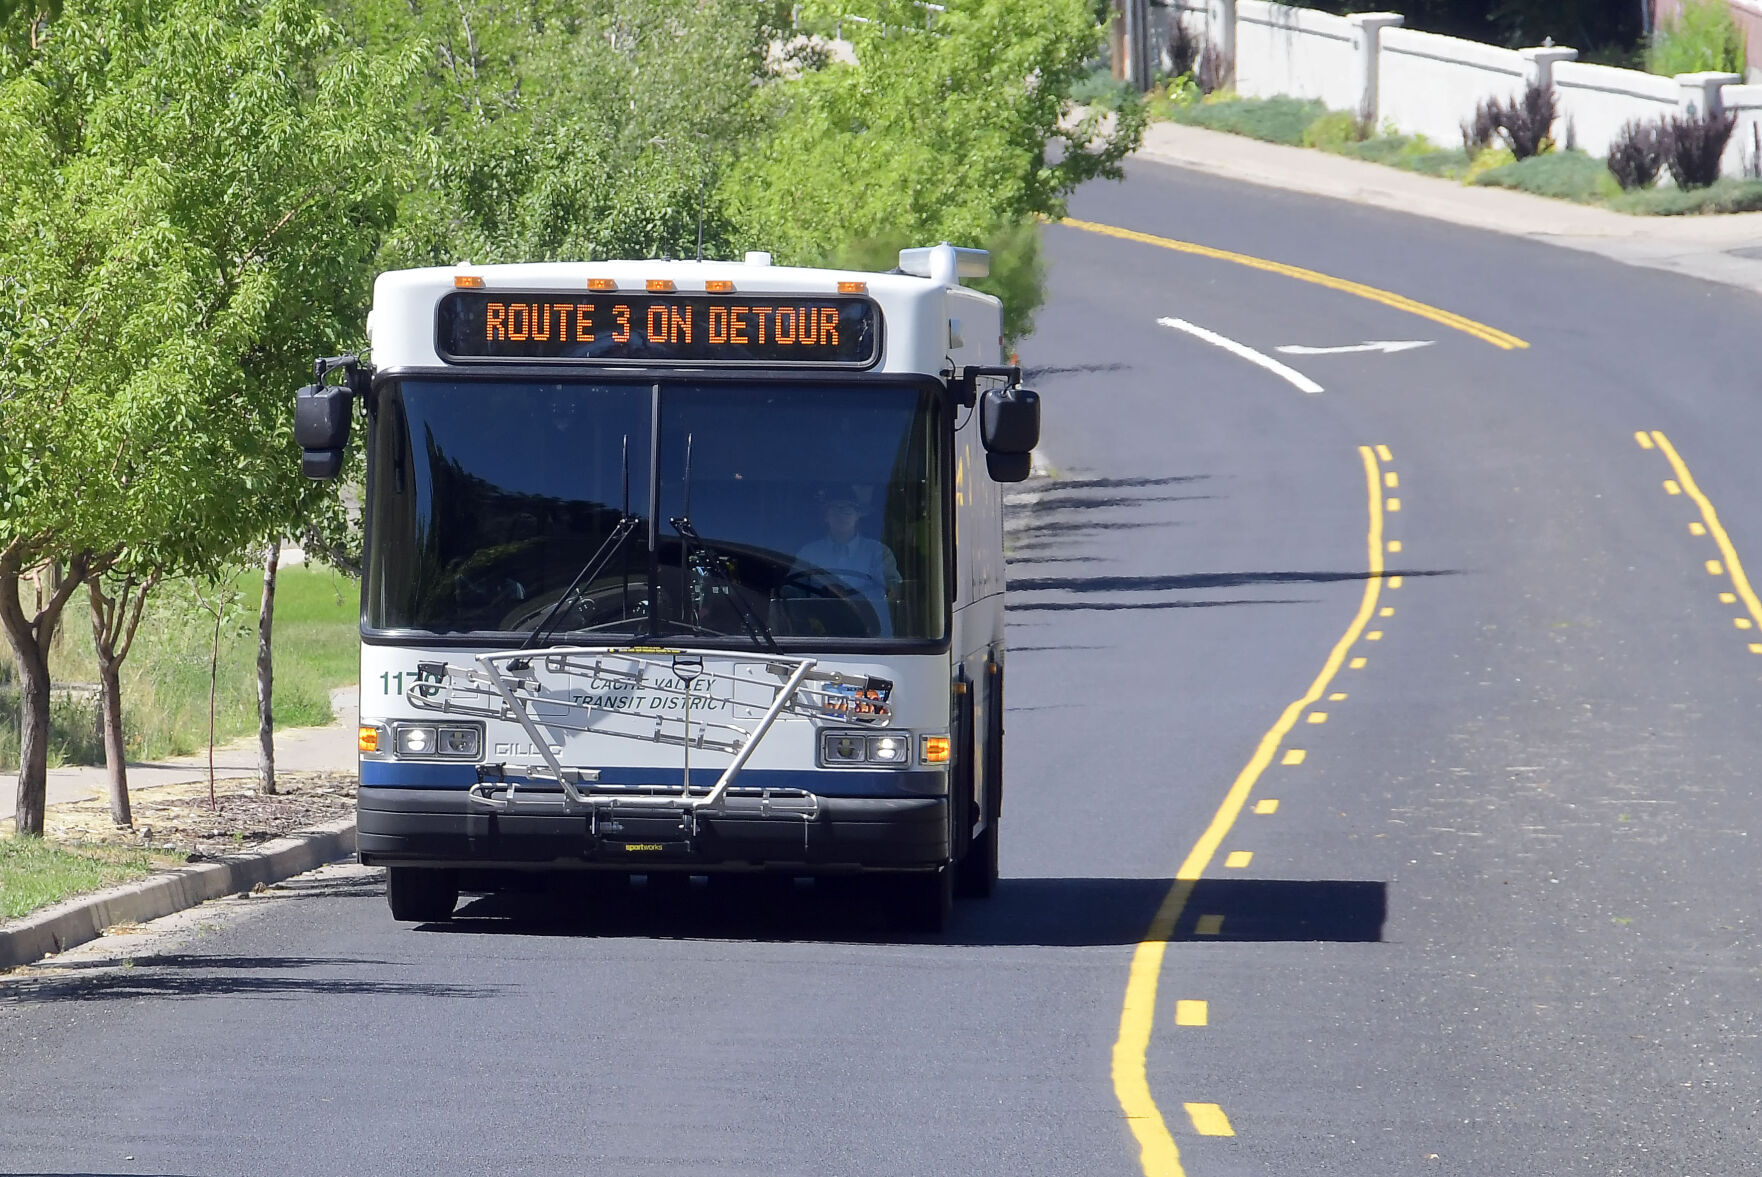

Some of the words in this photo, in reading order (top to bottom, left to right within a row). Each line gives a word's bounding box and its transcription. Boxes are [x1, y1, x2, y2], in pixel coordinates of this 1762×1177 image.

[486, 303, 595, 342] ROUTE
[612, 304, 630, 343] 3
[647, 305, 692, 344] ON
[709, 306, 839, 345] DETOUR
[654, 678, 716, 691] VALEY
[572, 695, 646, 709] TRANSIT
[650, 696, 732, 710] DISTRICT
[495, 742, 563, 757] GILLG
